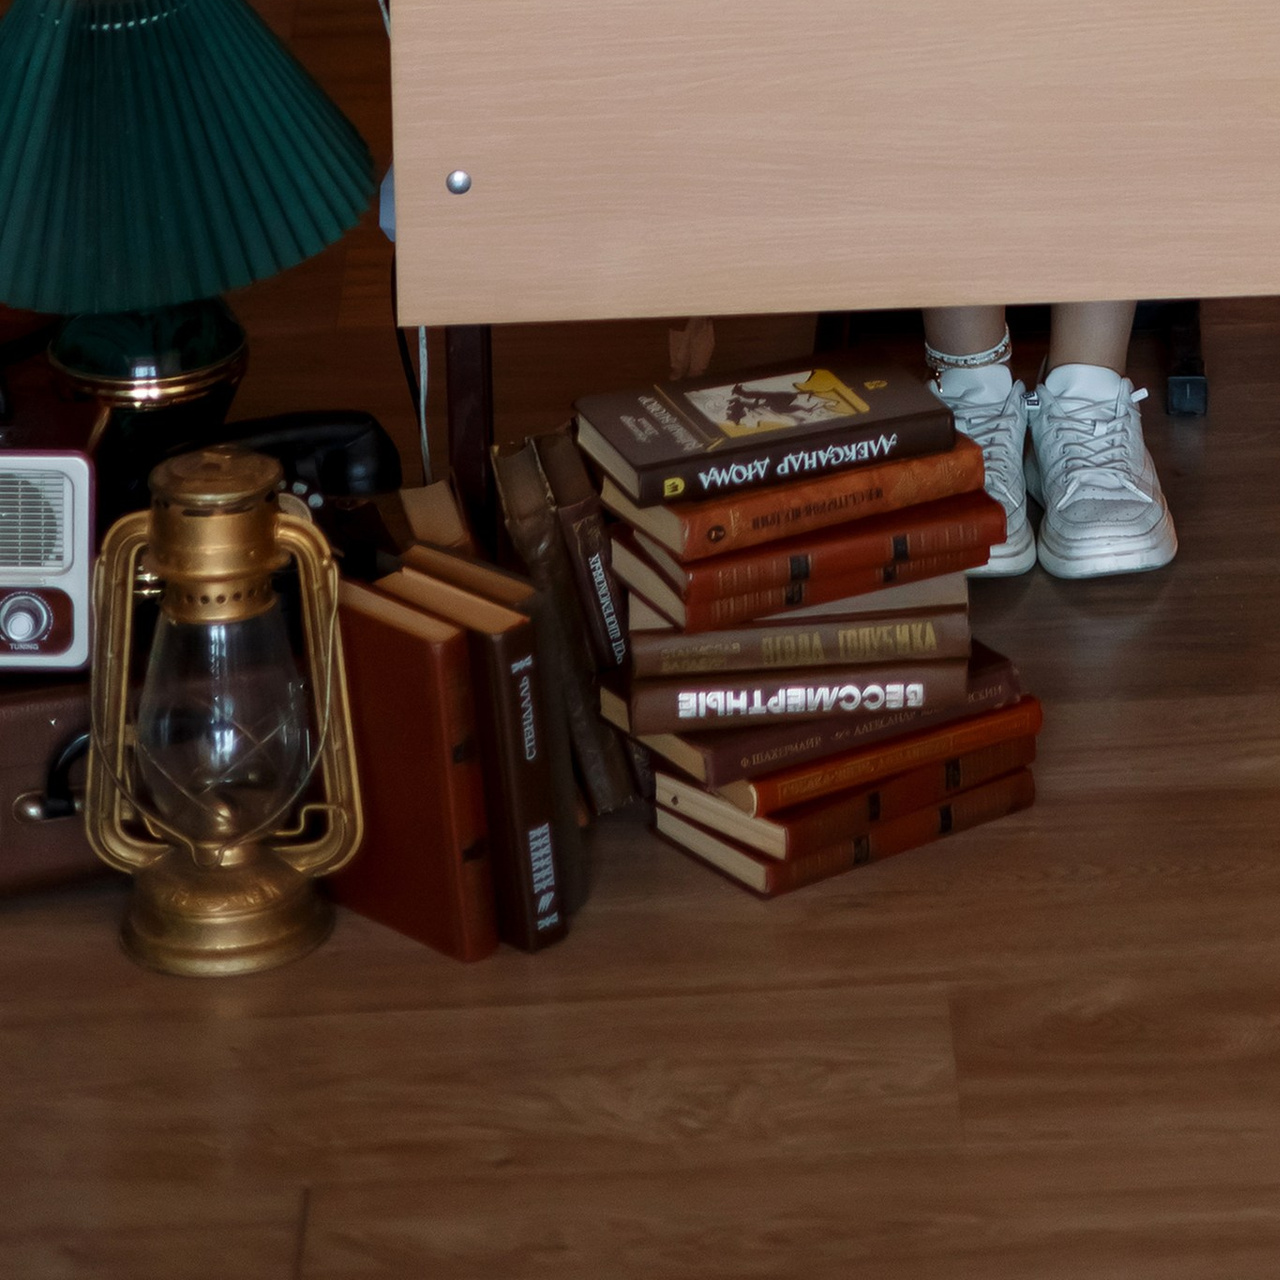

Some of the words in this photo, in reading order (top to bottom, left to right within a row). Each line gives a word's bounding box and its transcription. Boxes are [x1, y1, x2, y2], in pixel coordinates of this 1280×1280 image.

[698, 456, 771, 489] ДЮМА
[777, 432, 898, 477] АЛЕКСАНДР
[9, 643, 39, 651] TUNING
[838, 620, 939, 659] ГОЛУБИКА
[519, 675, 538, 762] СТЕНДАЛЬ
[677, 682, 925, 719] БЕССМЕРТНЫЕ
